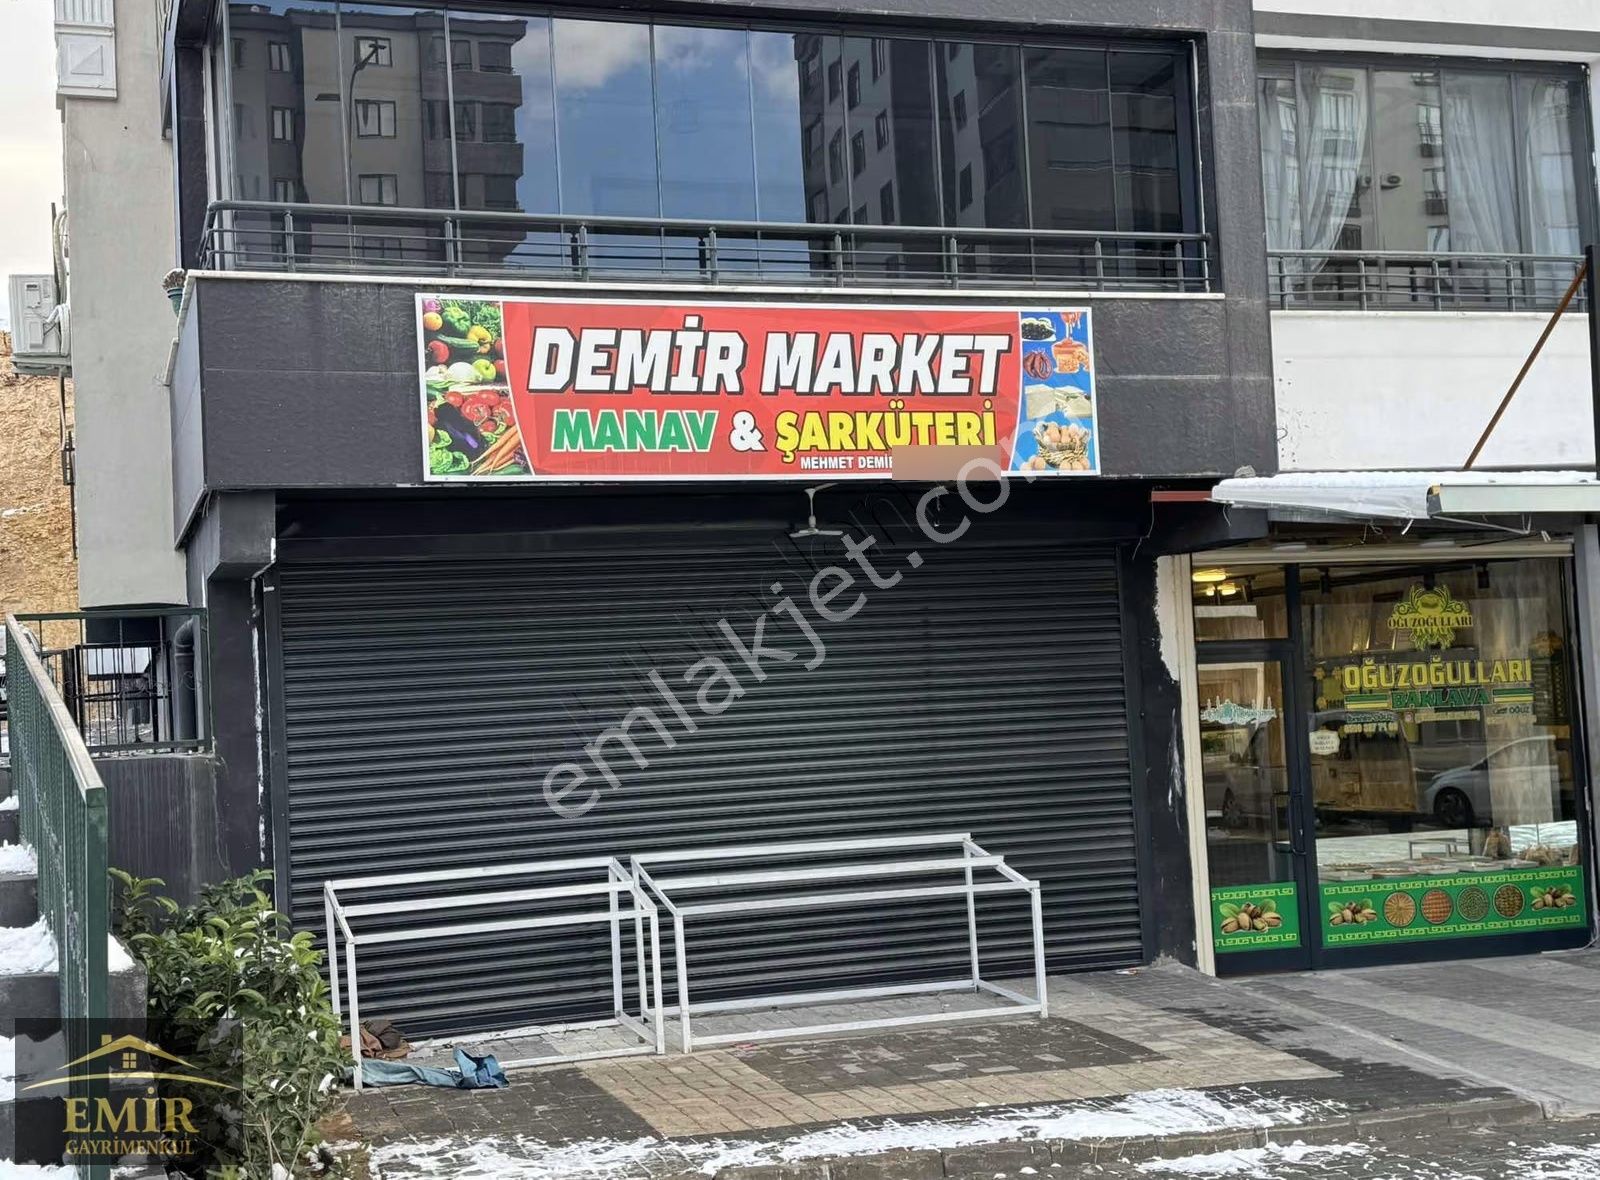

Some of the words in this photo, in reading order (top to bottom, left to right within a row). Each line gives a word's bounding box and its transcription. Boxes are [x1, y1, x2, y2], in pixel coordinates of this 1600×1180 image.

[527, 315, 747, 395] DEMİR
[759, 331, 1012, 395] MARKET
[550, 409, 719, 452] MANAV
[729, 411, 765, 452] &
[775, 398, 998, 464] ŞARKÜTERİ
[800, 455, 854, 470] MEHMET
[1343, 654, 1532, 690] OĞUZOĞULLARI
[1391, 688, 1491, 709] BAKLAVA
